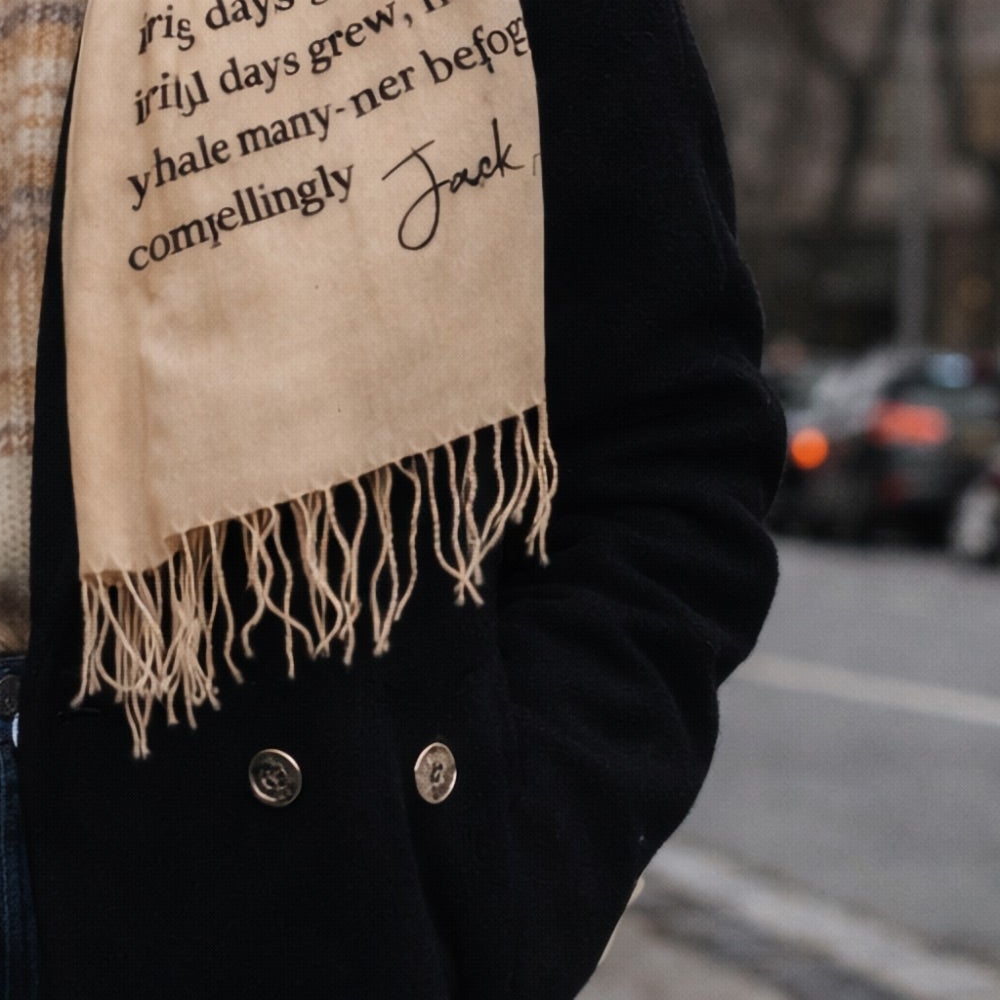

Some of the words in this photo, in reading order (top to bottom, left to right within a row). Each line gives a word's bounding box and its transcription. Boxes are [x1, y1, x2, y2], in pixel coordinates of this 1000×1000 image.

[219, 56, 301, 94] days
[308, 2, 413, 74] grew,
[382, 117, 525, 251] Jack
